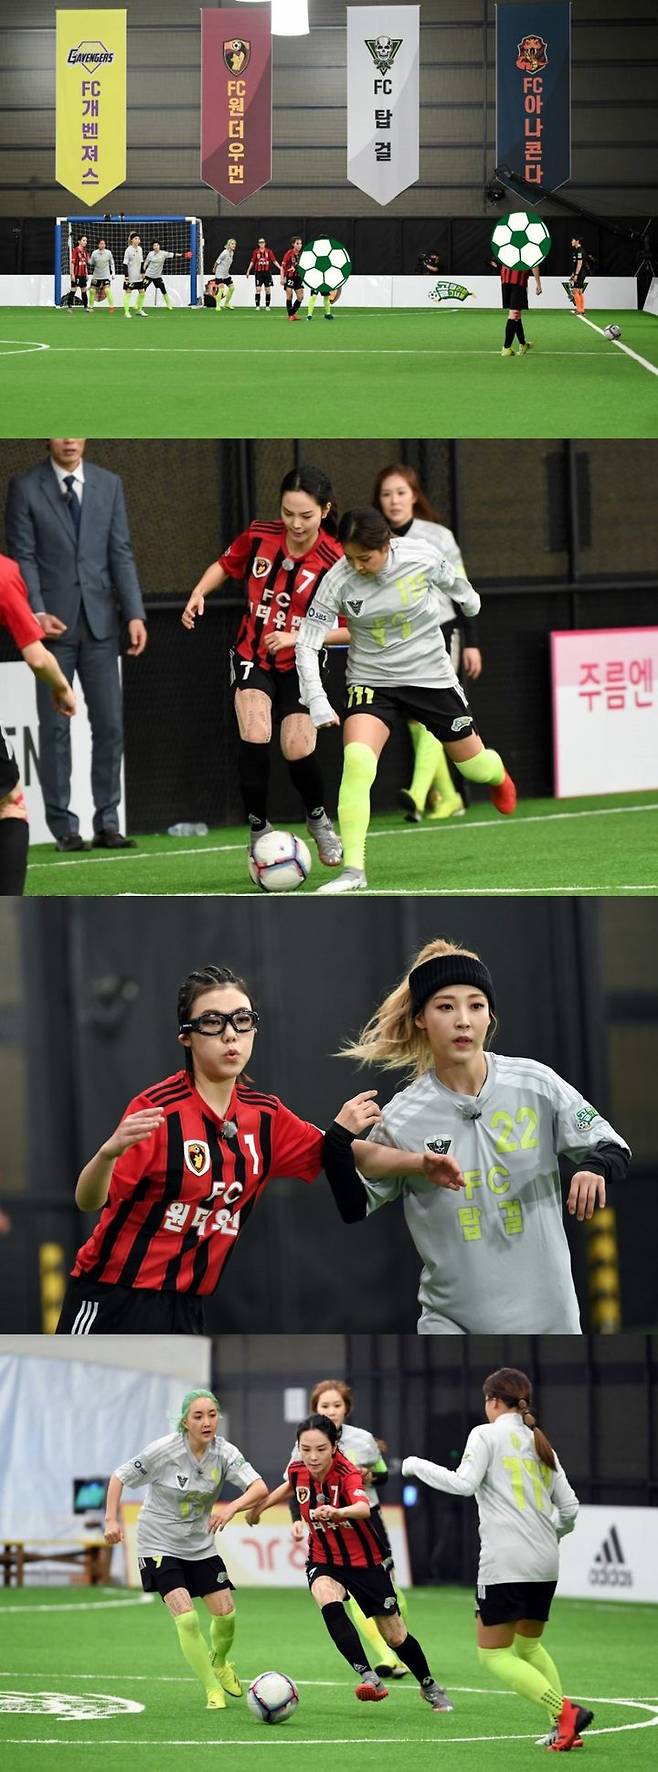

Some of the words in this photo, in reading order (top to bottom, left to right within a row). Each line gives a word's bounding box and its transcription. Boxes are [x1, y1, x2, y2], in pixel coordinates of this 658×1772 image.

[81, 81, 101, 97] FC
[227, 80, 245, 95] FC
[374, 79, 392, 95] FC
[523, 77, 543, 94] FC
[81, 99, 99, 185] 개벤져스
[228, 97, 244, 184] 원더우먼
[524, 95, 543, 185] 아나콘다
[296, 569, 316, 594] 7
[262, 588, 291, 608] FC
[250, 602, 306, 633] 더우
[240, 661, 254, 680] 7
[579, 658, 653, 713] 주름엔
[490, 1106, 540, 1154] 22
[243, 1134, 259, 1175] 1
[206, 1181, 243, 1204] FC
[463, 1166, 511, 1200] FC
[330, 1485, 339, 1506] 7
